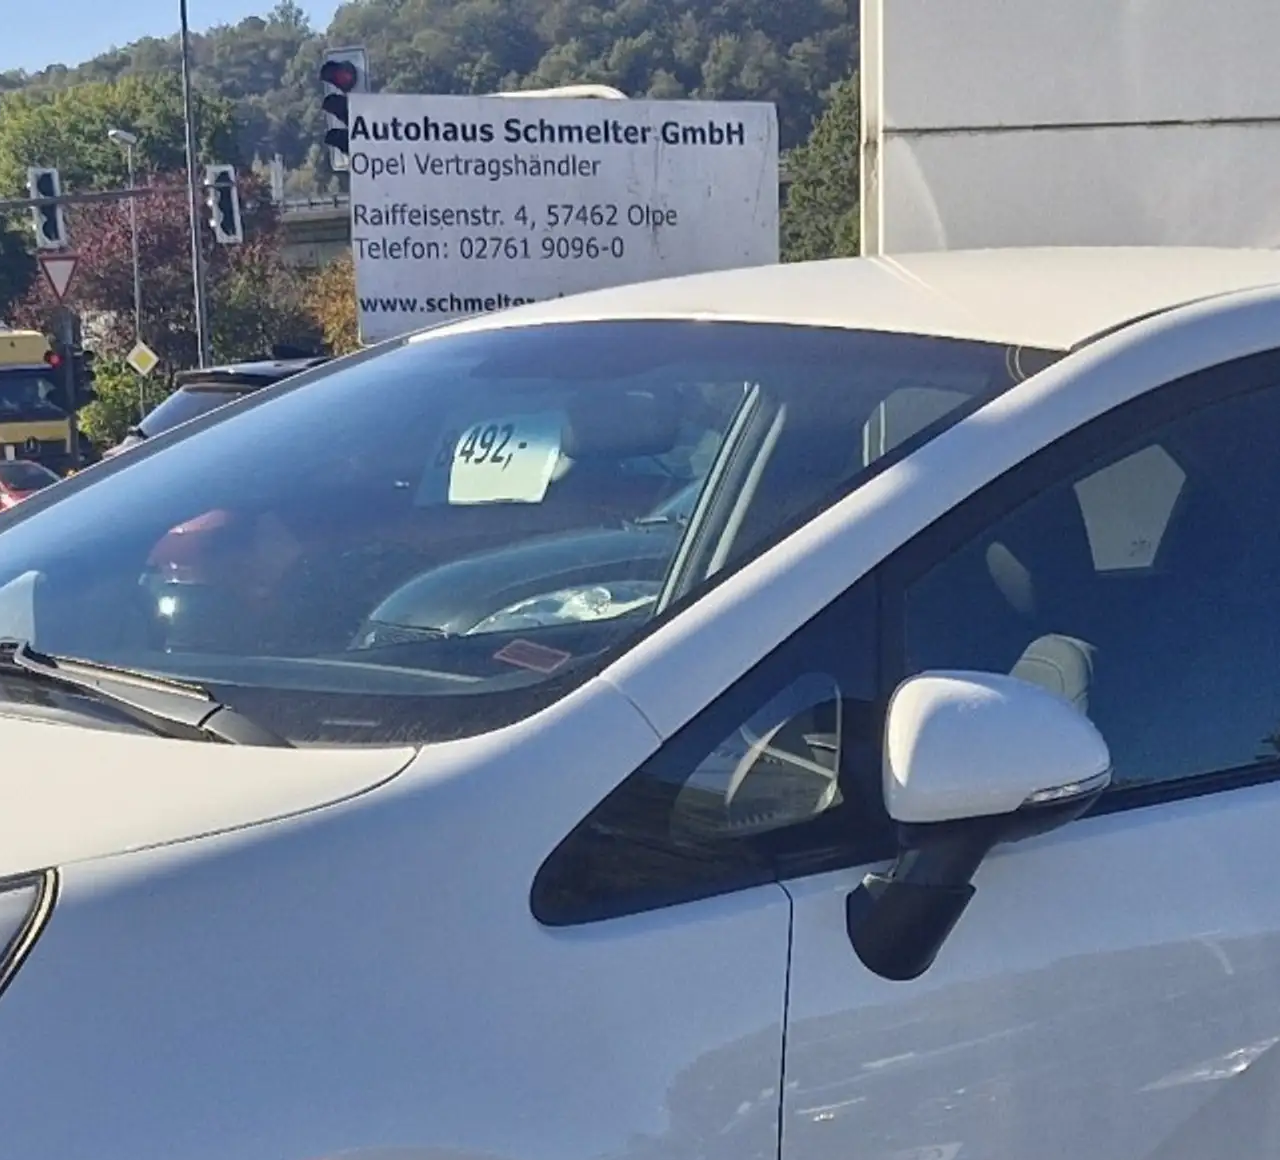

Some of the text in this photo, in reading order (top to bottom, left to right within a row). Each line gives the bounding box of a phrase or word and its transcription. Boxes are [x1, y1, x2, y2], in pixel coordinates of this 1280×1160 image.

[350, 115, 745, 146] Autohaus Schmelter GmbH
[351, 151, 601, 182] Opel Vertragshändler
[353, 203, 678, 231] Raiffeisenstr. 4, 57462 Olpe
[354, 236, 624, 260] Telefon: 02761 9096-0
[360, 293, 536, 313] www.schmelte
